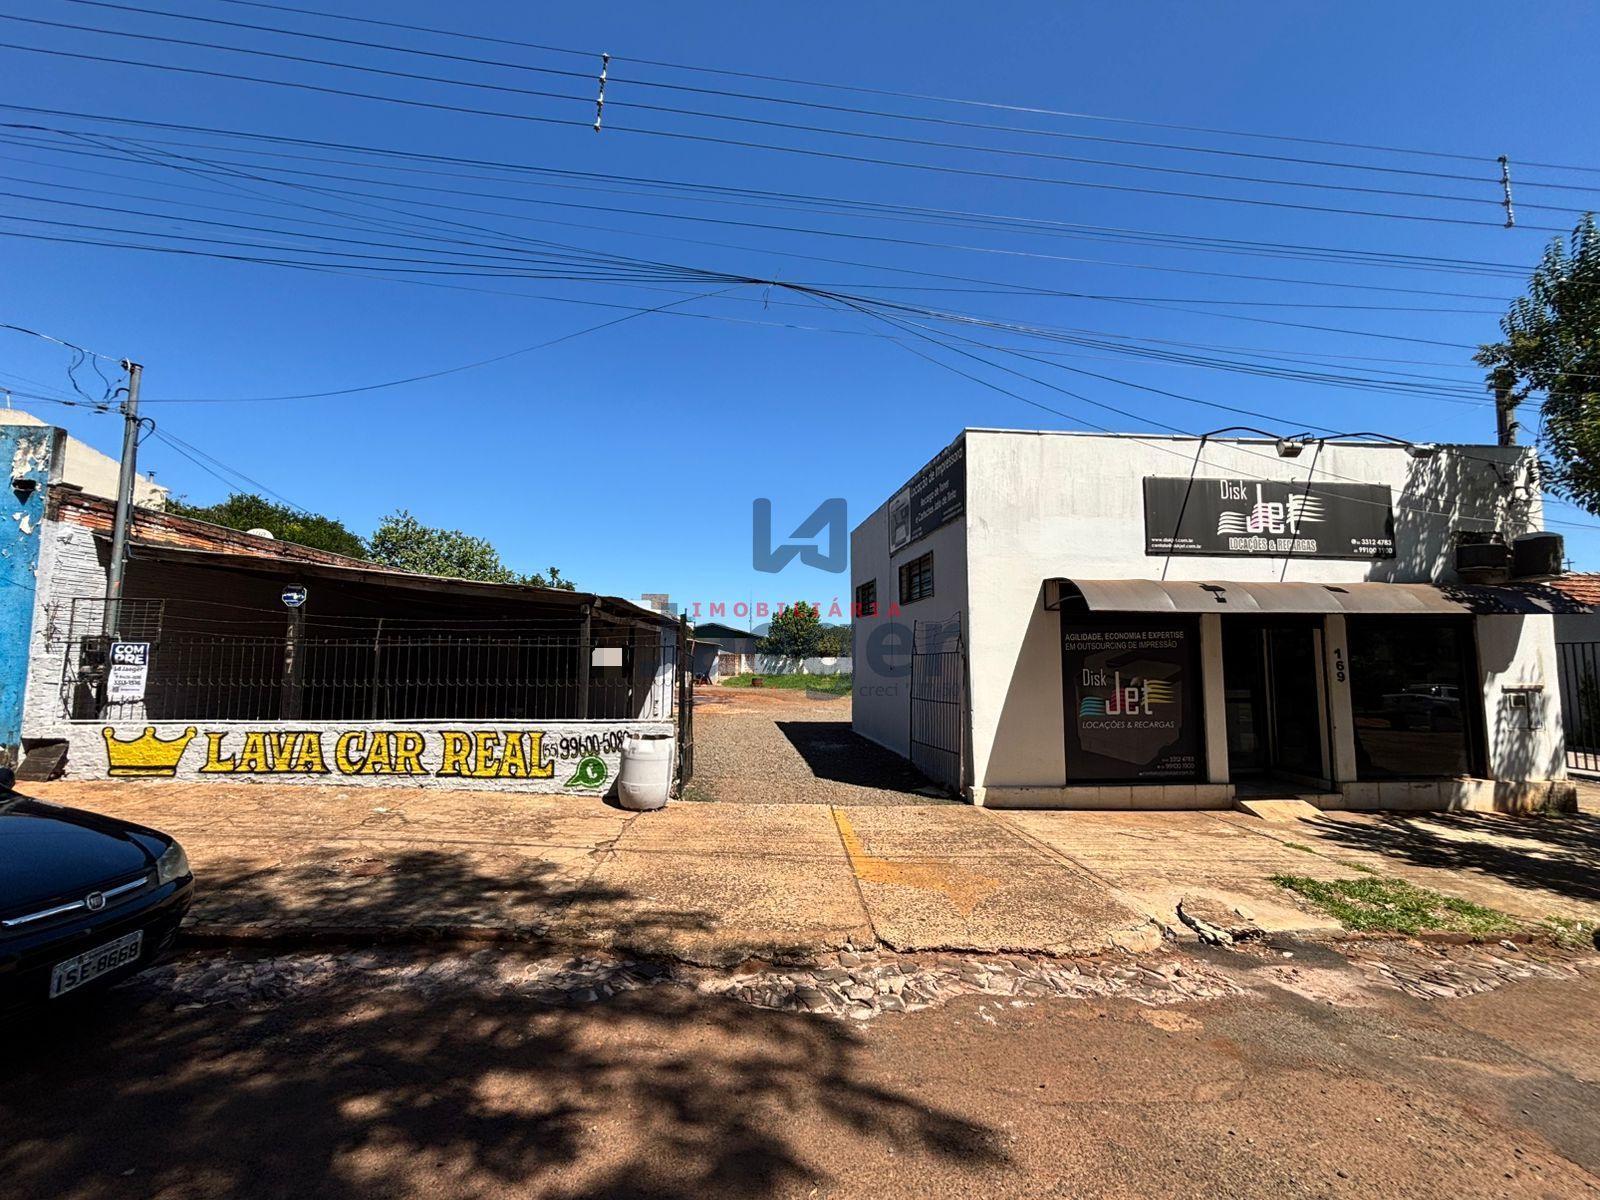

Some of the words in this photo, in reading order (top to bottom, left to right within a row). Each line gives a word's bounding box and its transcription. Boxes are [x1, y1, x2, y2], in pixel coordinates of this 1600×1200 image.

[1220, 479, 1247, 501] Disk
[1246, 483, 1301, 534] Jet
[1229, 536, 1267, 552] LOCAÇÕES
[1268, 540, 1277, 551] &
[1277, 537, 1317, 552] RECARGAS
[1064, 632, 1104, 641] AGILIDADE,
[1104, 631, 1141, 640] ECONOMIA
[1142, 631, 1147, 640] E
[1148, 631, 1184, 639] EXPERTISE
[115, 645, 145, 654] COM
[1065, 642, 1076, 651] EM
[1077, 641, 1126, 651] OUTSOURCING
[1128, 641, 1137, 649] DE
[1139, 639, 1178, 649] IMPRESSÃO
[114, 654, 144, 665] PRE
[1334, 648, 1345, 682] 169
[1083, 668, 1107, 687] Disk
[1082, 720, 1125, 730] LOCAÇÕES
[1127, 721, 1133, 729] &
[1134, 720, 1175, 729] RECARGAS
[199, 731, 332, 774] LAVA
[335, 731, 431, 775] CAR
[436, 731, 555, 778] REAL
[543, 741, 558, 760] (55)
